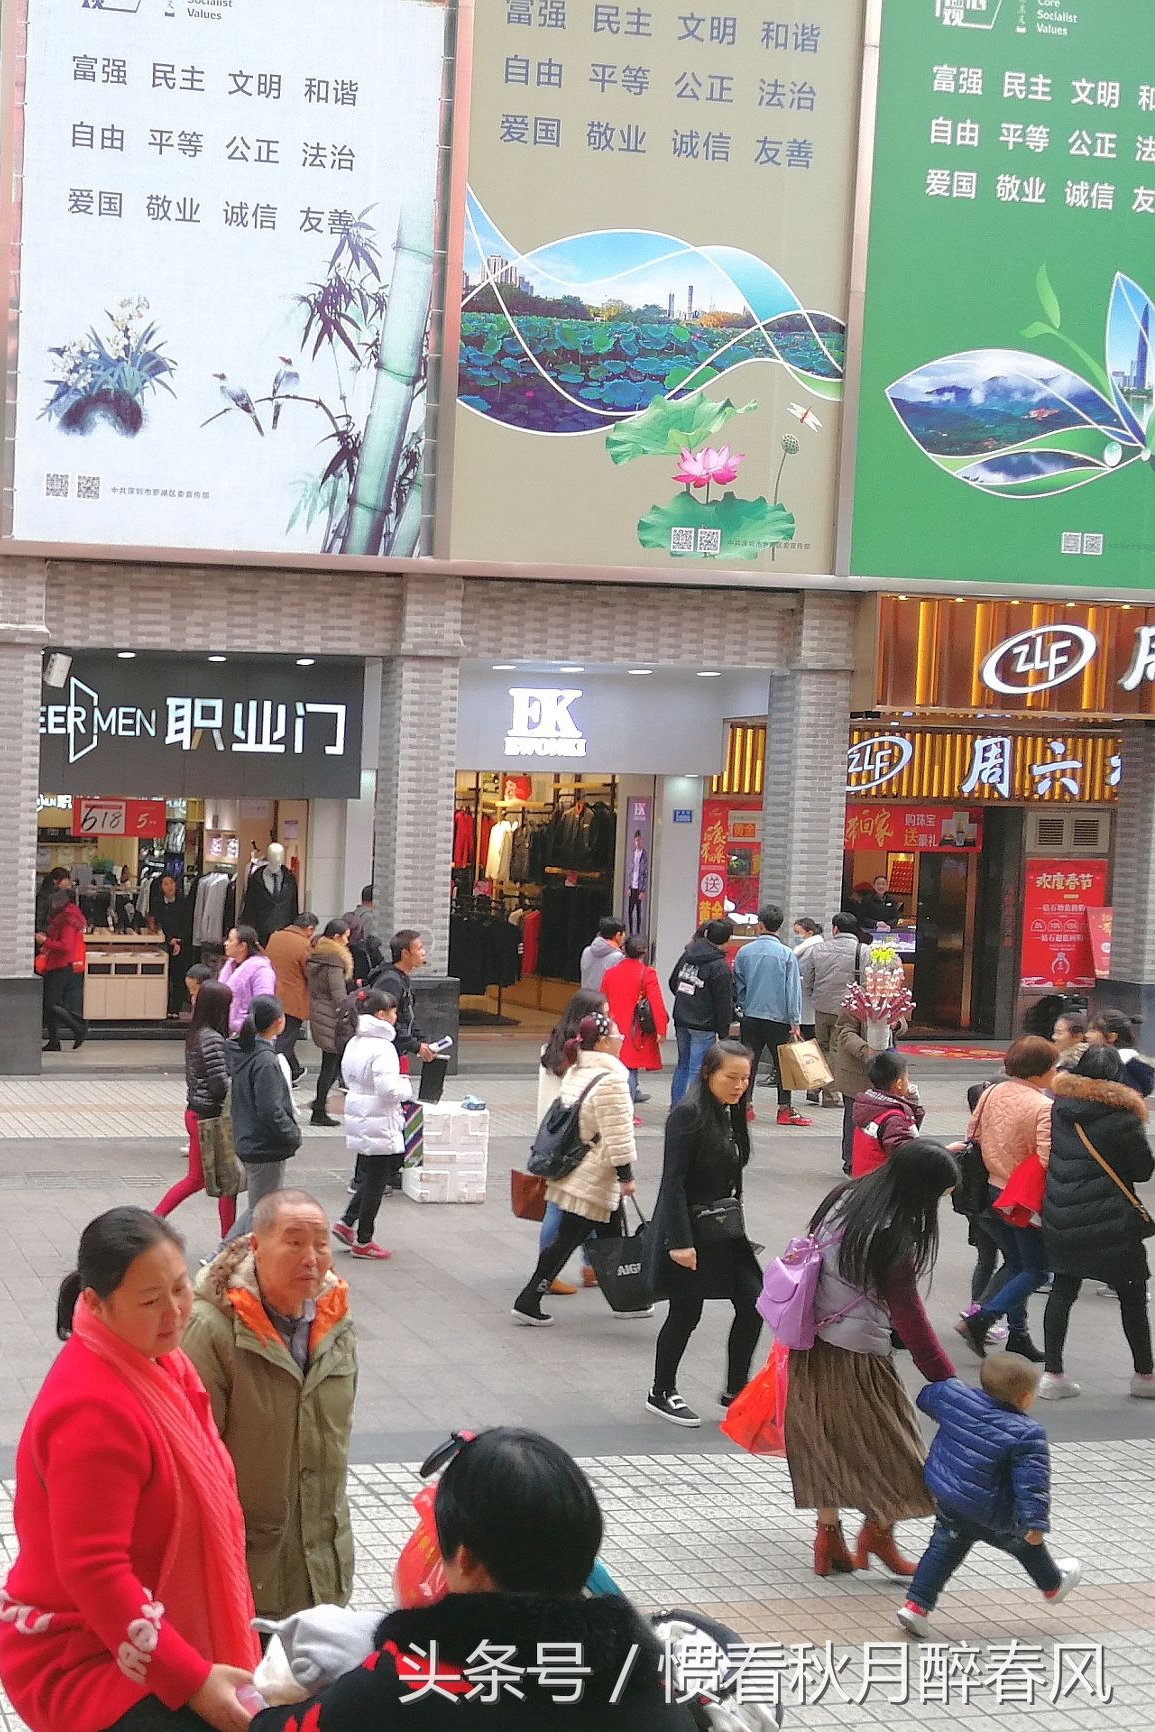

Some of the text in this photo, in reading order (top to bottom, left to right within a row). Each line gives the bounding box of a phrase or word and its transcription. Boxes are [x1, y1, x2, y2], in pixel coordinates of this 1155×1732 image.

[187, 8, 222, 20] Values
[507, 0, 821, 53] 富强 民主 文明 和谐
[1036, 22, 1068, 36] Values
[1037, 9, 1078, 24] Socialist
[72, 54, 359, 107] 富强 民主 文明 和谐
[505, 55, 816, 111] 自由 平等 公正 法治
[932, 64, 983, 95] 富强
[1003, 71, 1052, 101] 民主
[1070, 78, 1120, 108] 文明
[71, 121, 355, 171] 自由 平等 公正 法治
[500, 114, 814, 169] 爱国 敬业 诚信 友善
[930, 117, 979, 147] 自由
[999, 123, 1050, 153] 平等
[1068, 130, 1117, 158] 公正
[68, 188, 356, 237] 爱国 敬业 诚信 友善
[925, 169, 977, 199] 爱国
[996, 174, 1046, 203] 敬业
[1064, 180, 1115, 210] 诚信
[1014, 635, 1073, 682] ZLF
[94, 707, 157, 737] MEN
[165, 697, 347, 756] 职业门
[507, 687, 583, 738] EK
[847, 744, 892, 781] ZLF
[961, 735, 1122, 799] 周六
